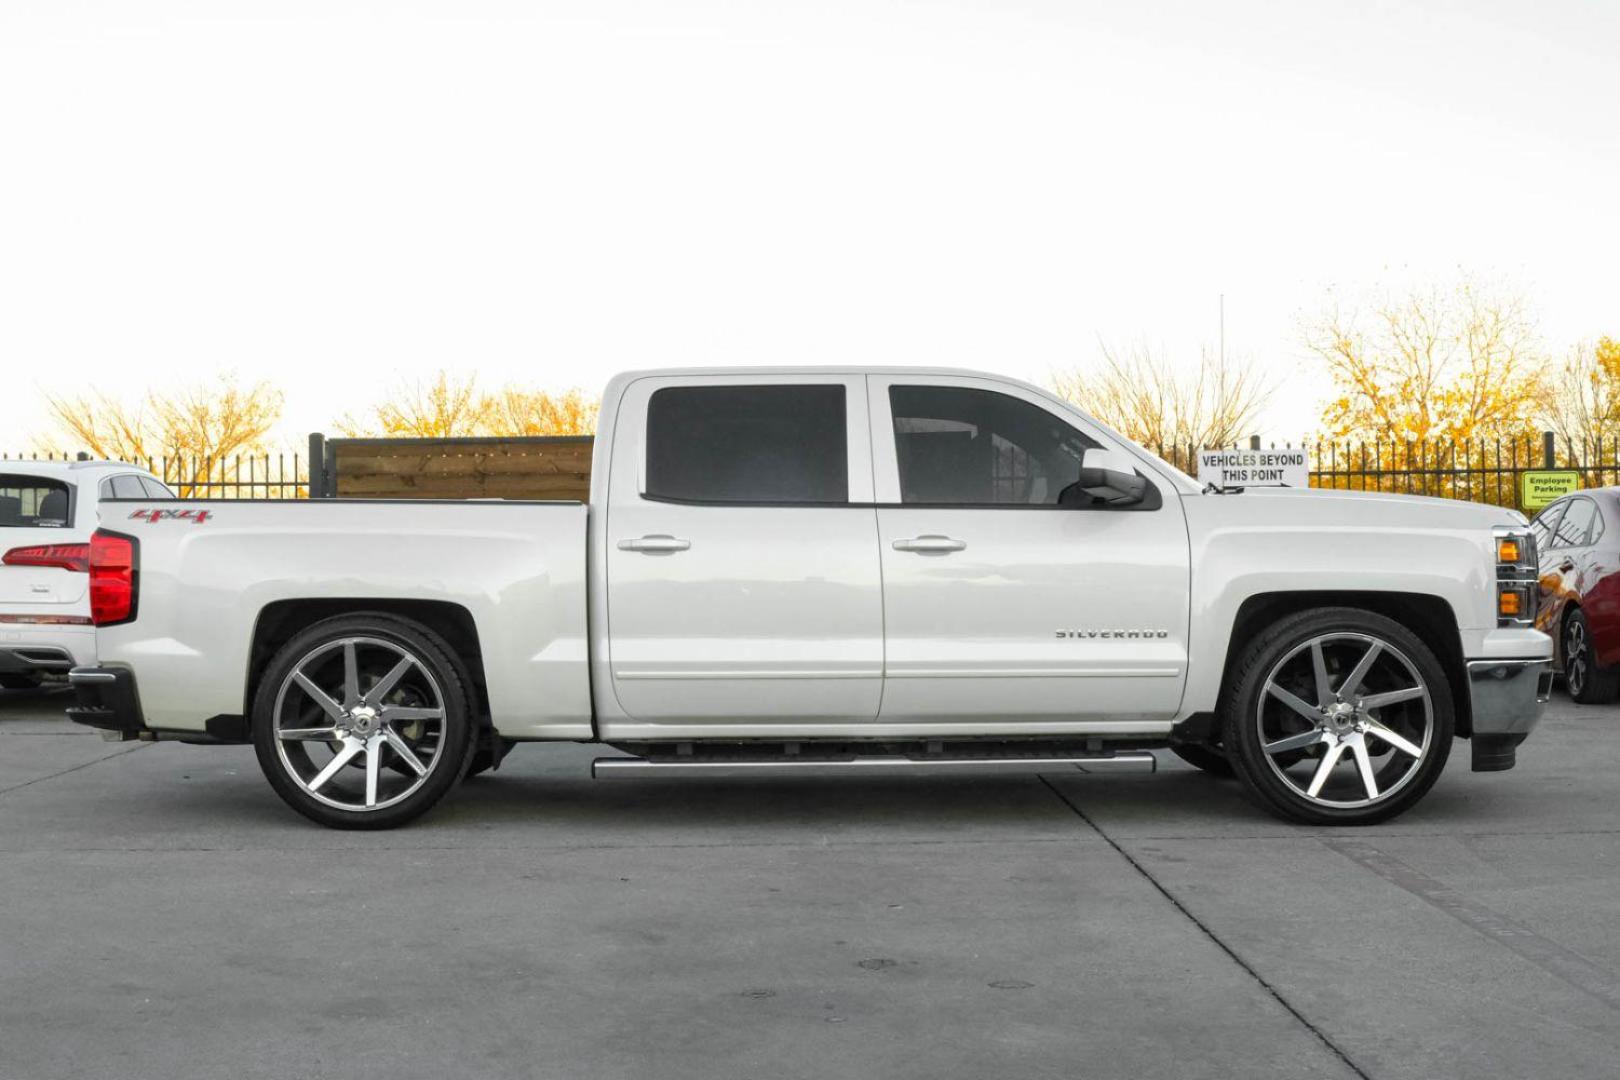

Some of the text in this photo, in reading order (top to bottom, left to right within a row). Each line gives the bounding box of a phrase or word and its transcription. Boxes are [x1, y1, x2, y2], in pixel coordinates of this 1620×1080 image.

[1203, 454, 1304, 467] VEHICLES BEYOND
[1223, 469, 1284, 481] THIS POINT
[1530, 477, 1572, 485] Employee
[1534, 485, 1568, 493] Parking
[1055, 628, 1168, 639] SILVERADO
